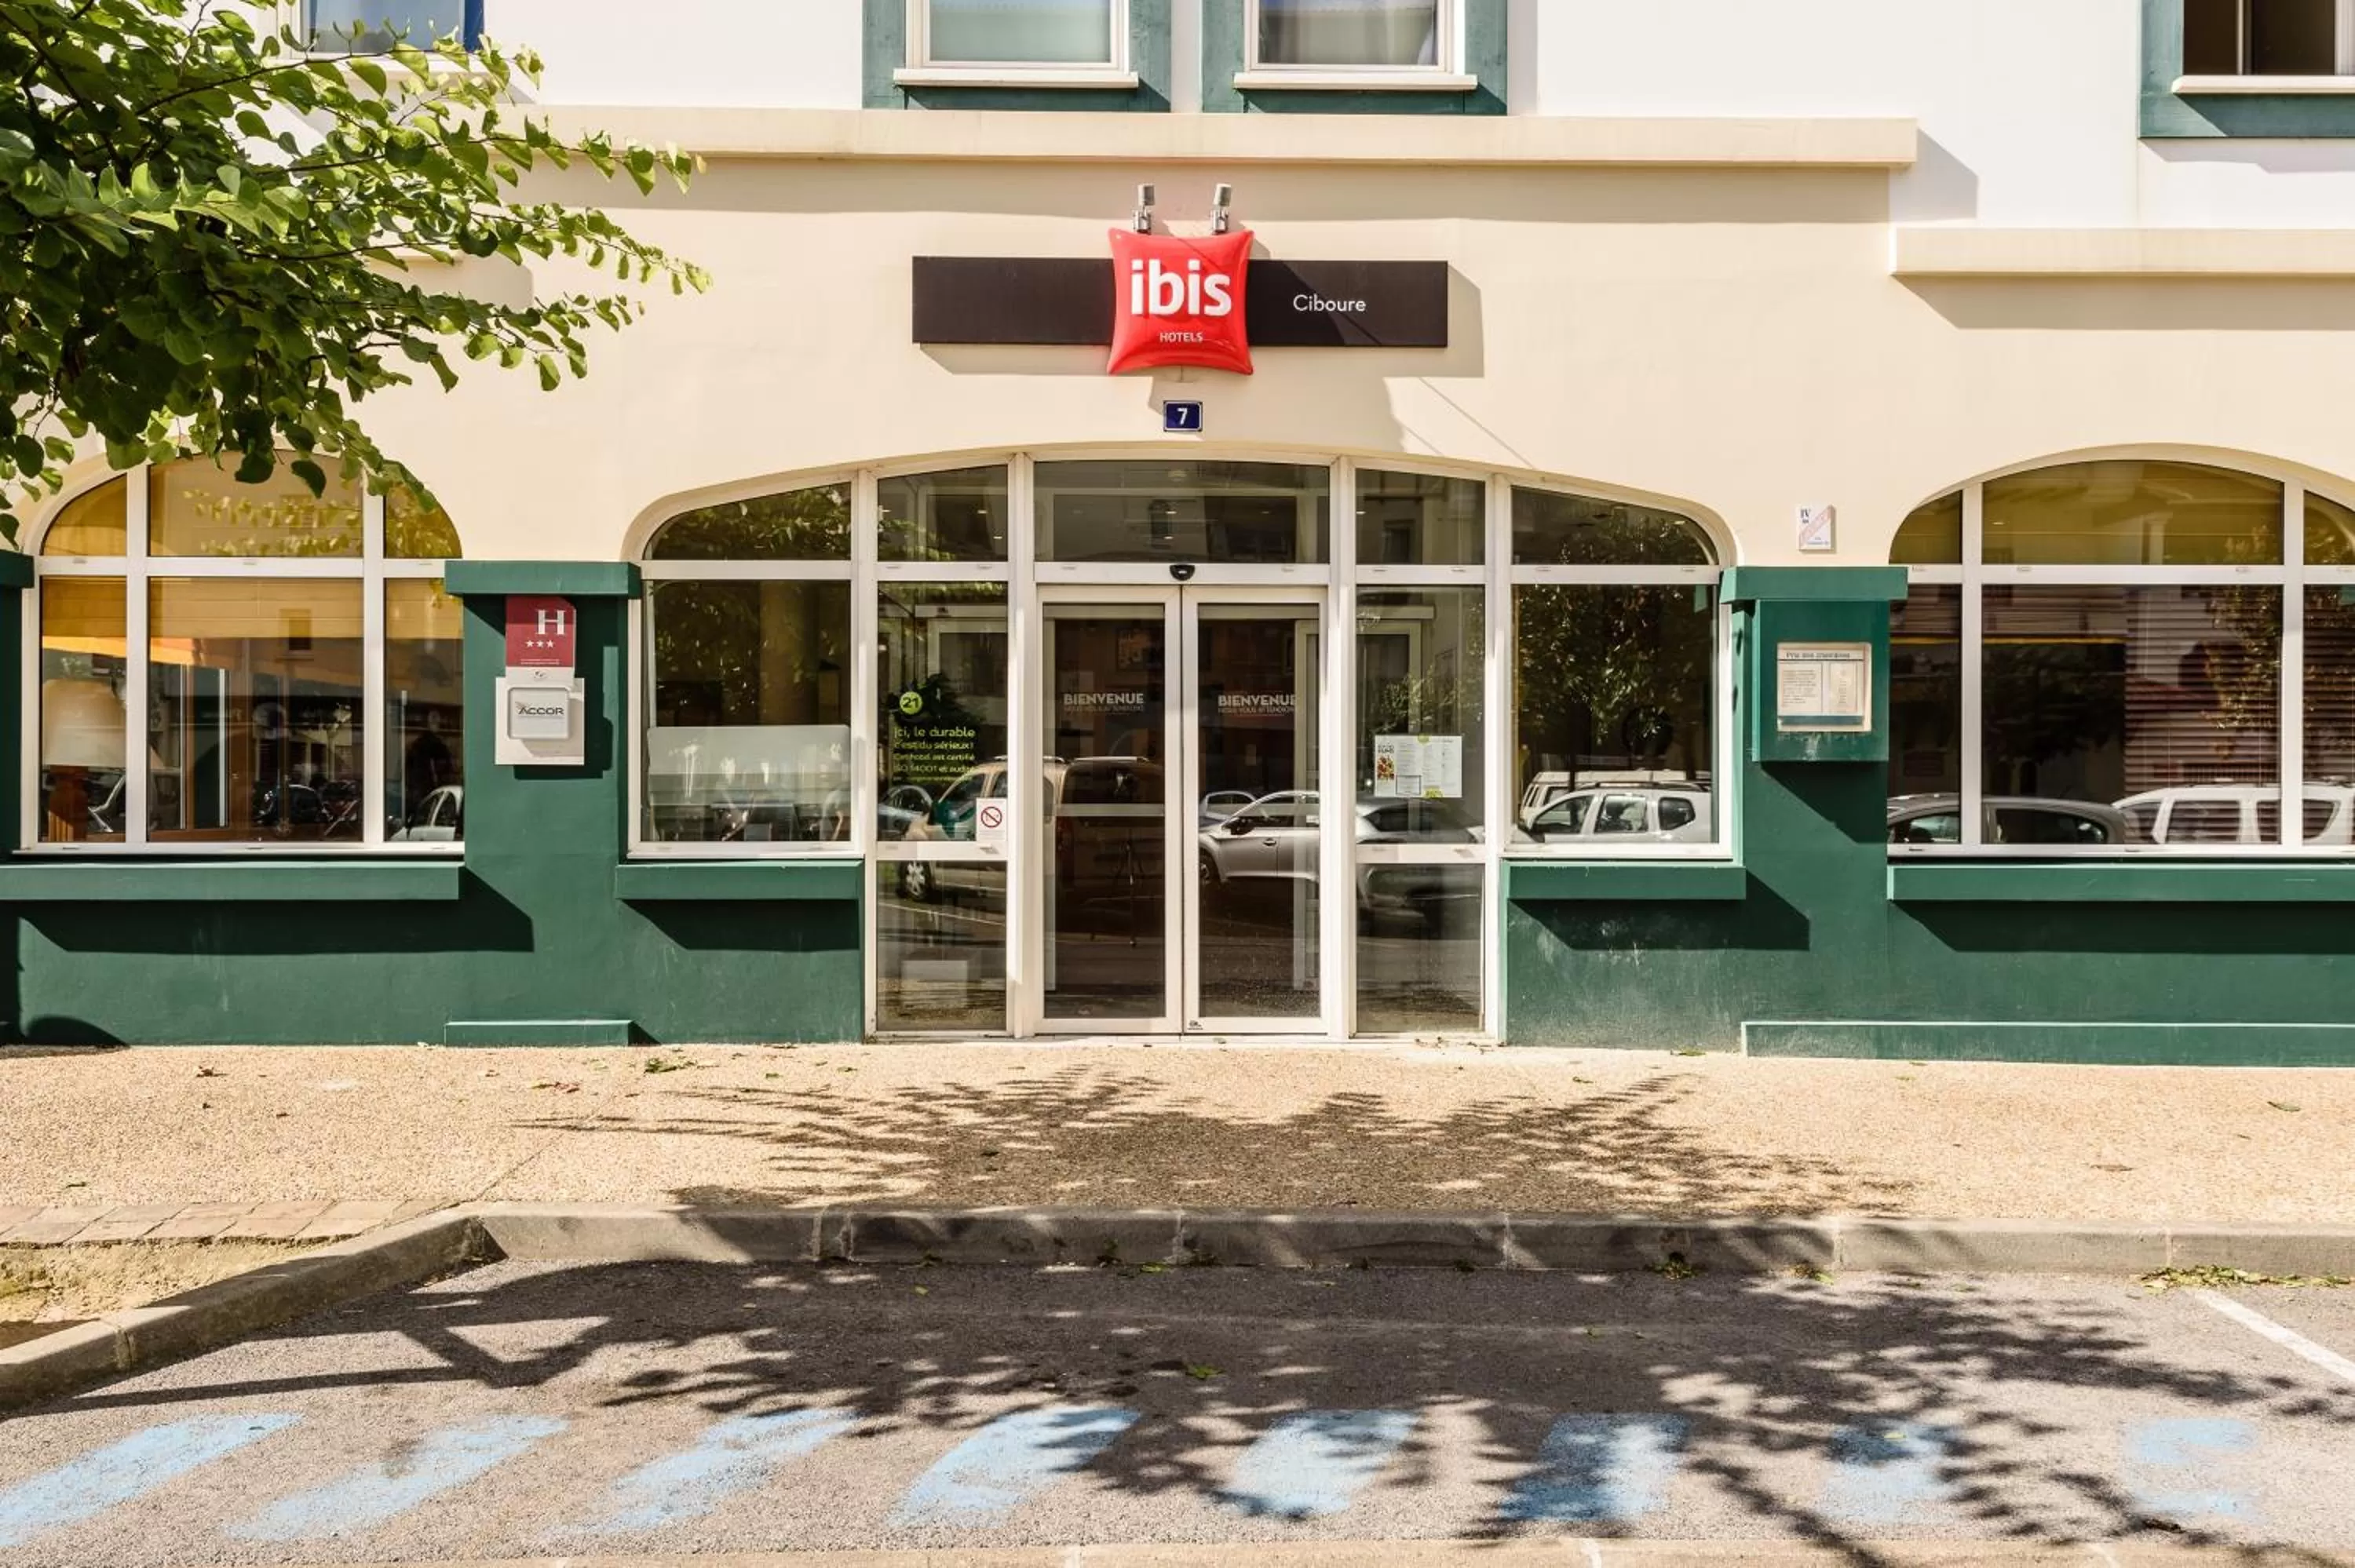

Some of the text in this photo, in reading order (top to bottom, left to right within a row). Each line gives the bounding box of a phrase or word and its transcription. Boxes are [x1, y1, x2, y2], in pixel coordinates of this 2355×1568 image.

[1131, 259, 1232, 316] ibis
[1293, 294, 1366, 312] Ciboure
[1159, 332, 1203, 343] HOTELS
[1178, 407, 1188, 425] 7
[535, 610, 565, 635] H
[902, 697, 919, 709] 21
[1064, 693, 1144, 705] BIENVENUE
[915, 726, 926, 737] le
[929, 726, 976, 737] durable
